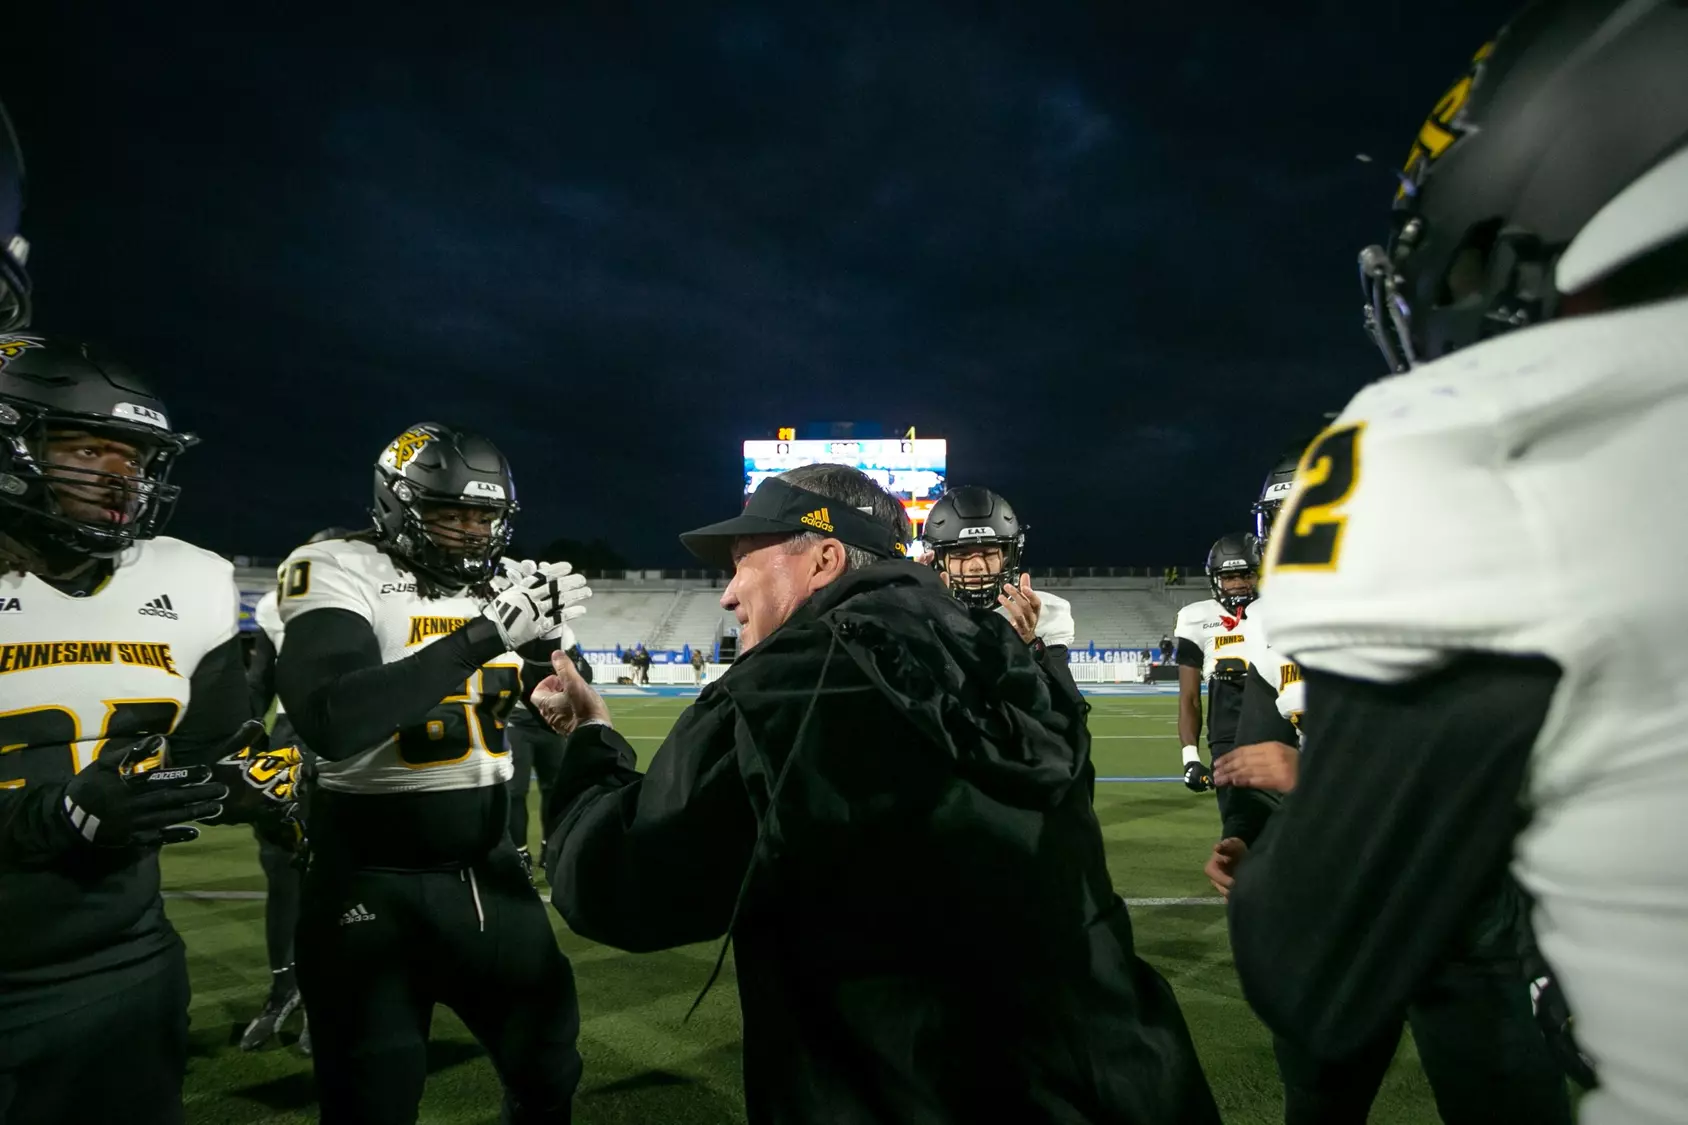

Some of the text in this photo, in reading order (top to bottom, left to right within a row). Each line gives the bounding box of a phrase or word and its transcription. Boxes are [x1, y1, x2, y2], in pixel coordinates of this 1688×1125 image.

[800, 515, 834, 533] adidas
[380, 582, 418, 595] C-US
[138, 607, 179, 621] adidas
[405, 615, 470, 647] KENNES
[1214, 634, 1245, 651] KENNES
[0, 641, 185, 679] ENNESAW STATE
[147, 769, 188, 781] ADIZERO
